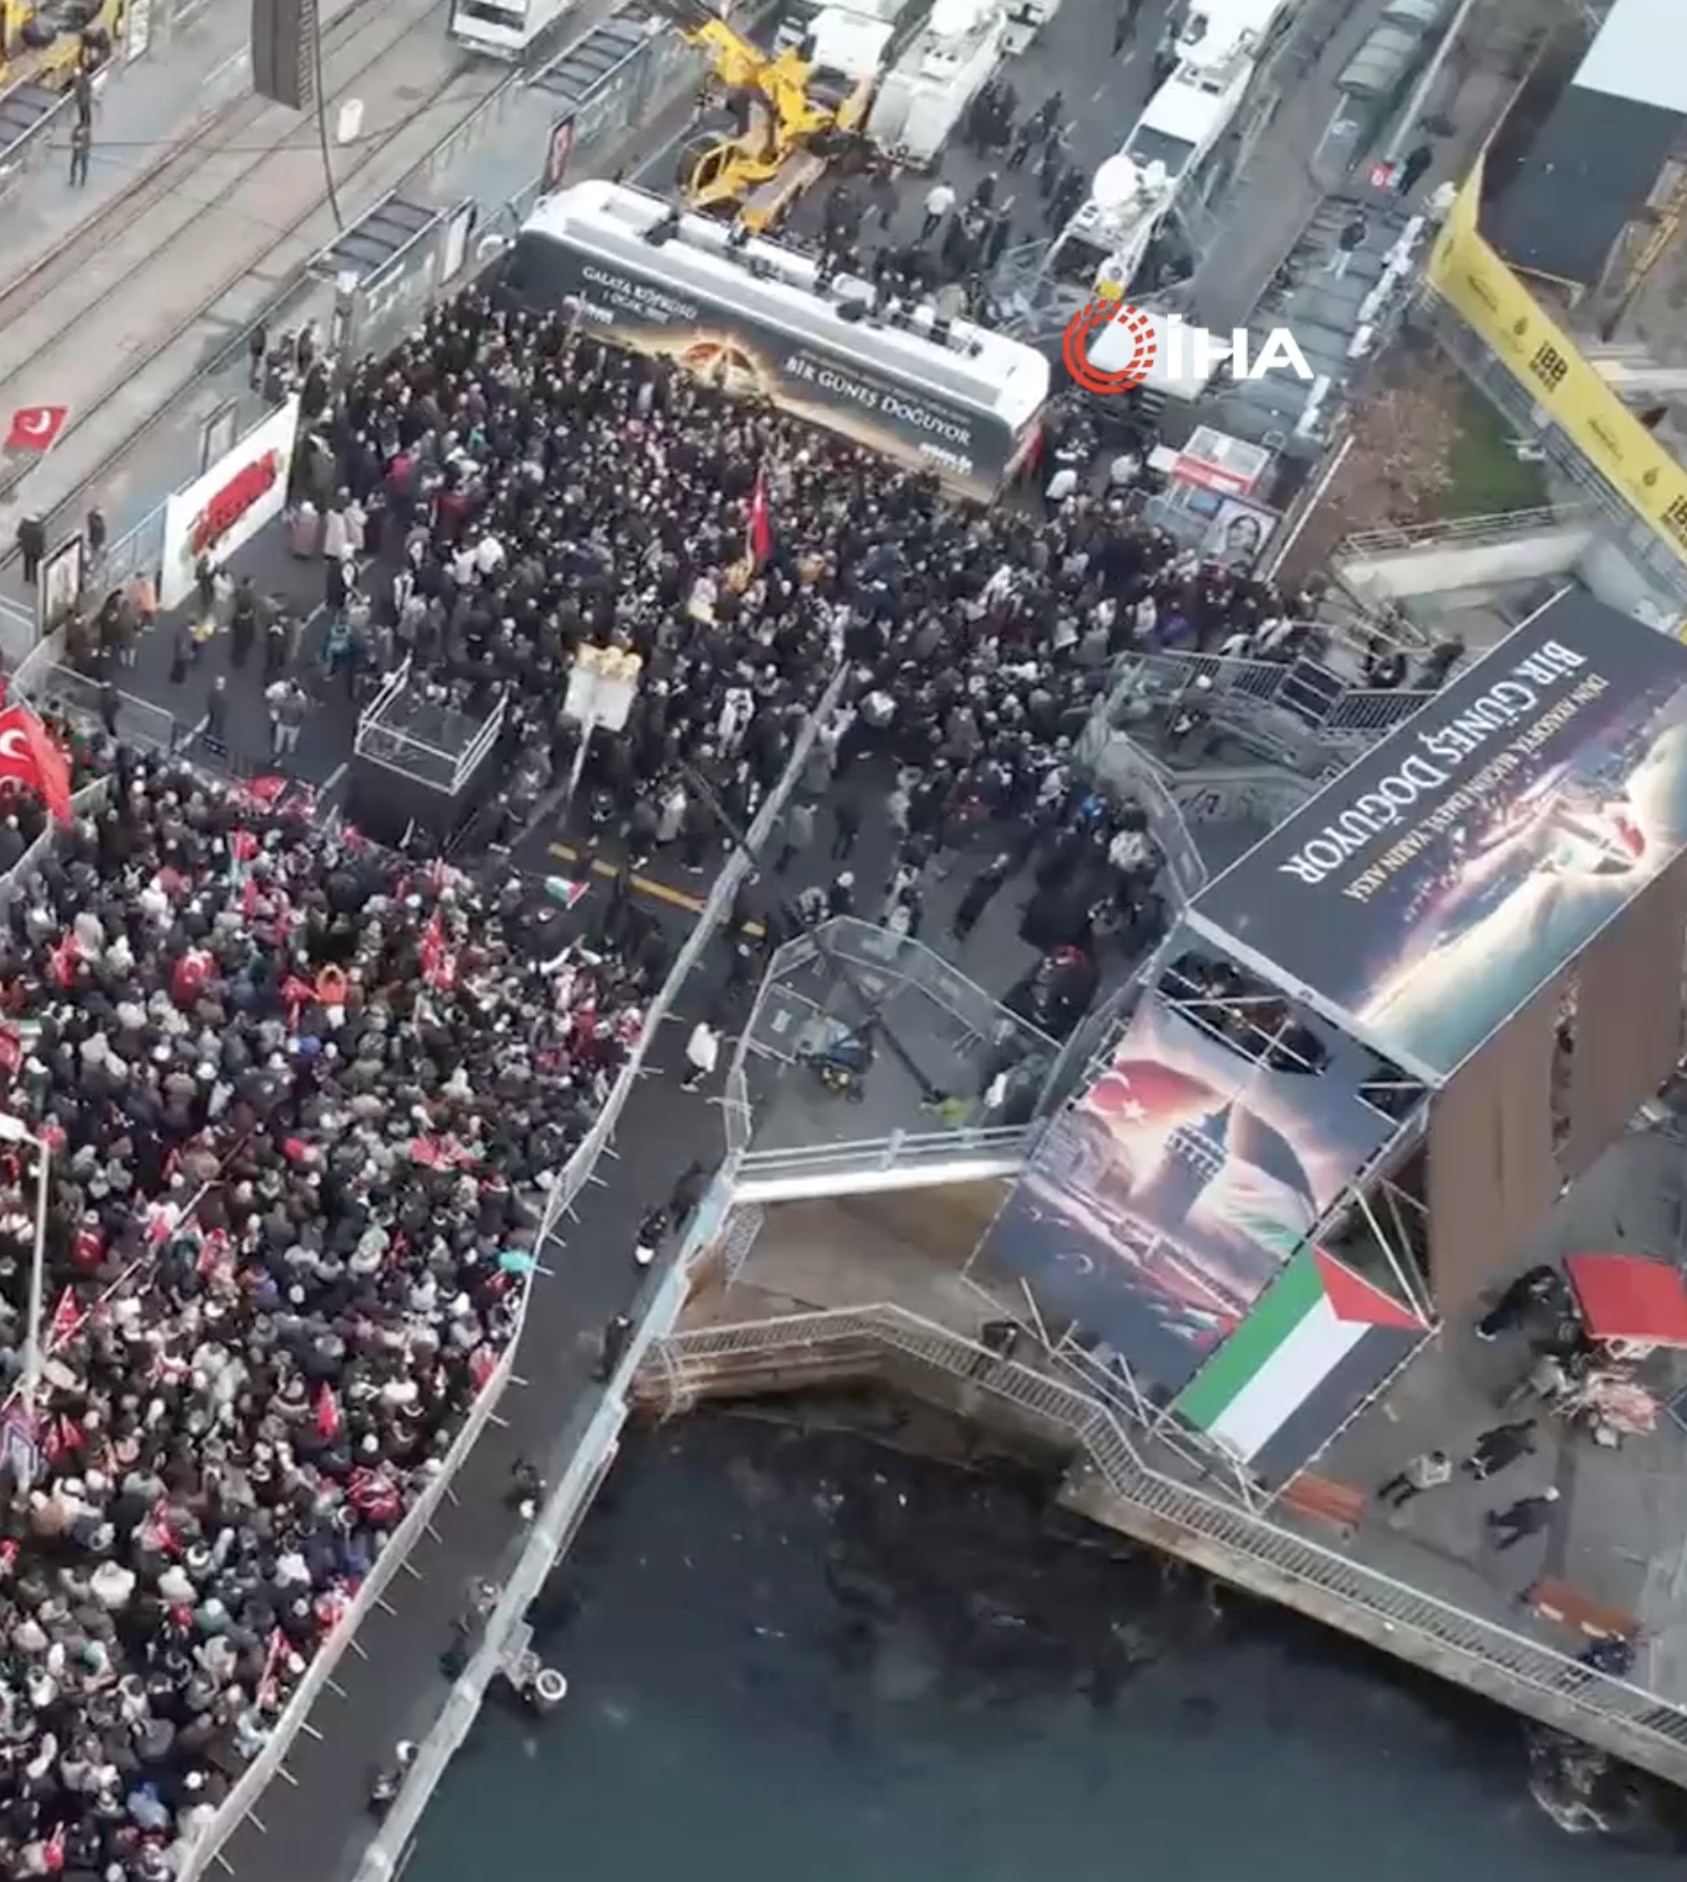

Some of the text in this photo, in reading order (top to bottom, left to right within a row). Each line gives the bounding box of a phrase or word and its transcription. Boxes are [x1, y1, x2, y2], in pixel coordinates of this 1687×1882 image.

[582, 265, 632, 295] GALATA
[1278, 640, 1587, 883] BİR GÜNEŞ DOĞUYOR
